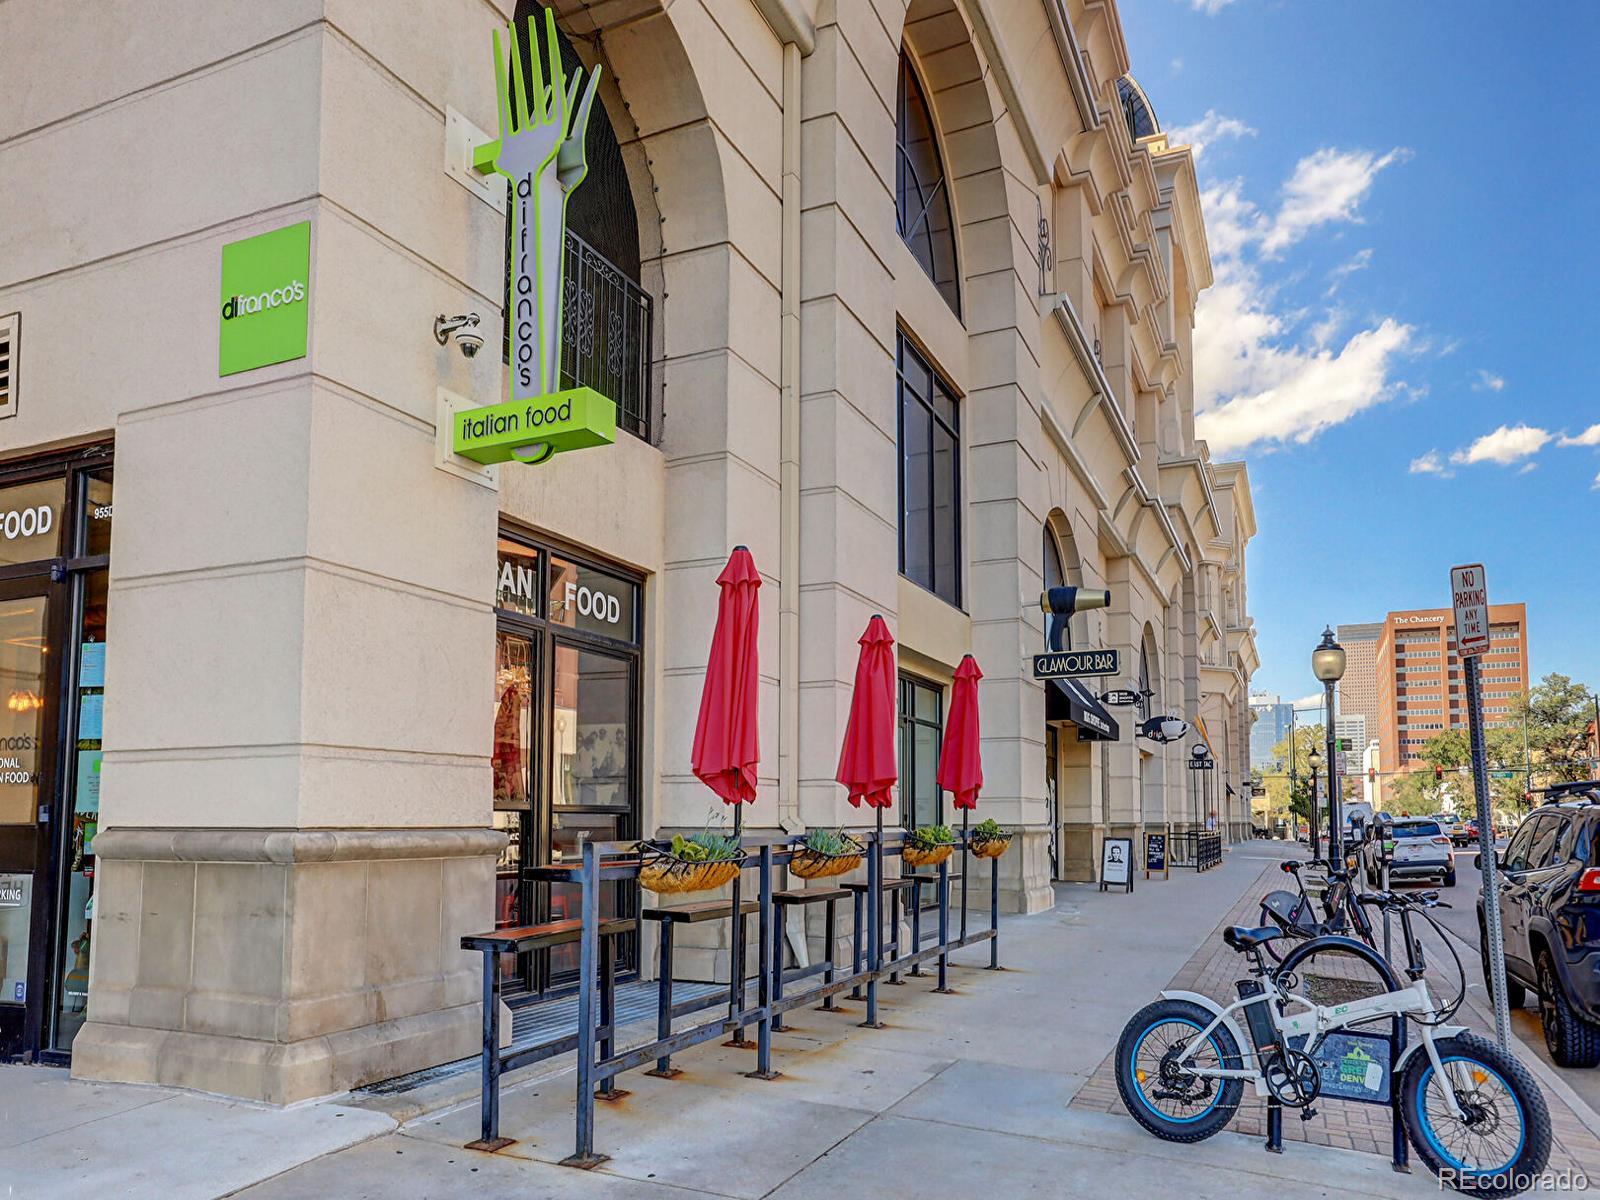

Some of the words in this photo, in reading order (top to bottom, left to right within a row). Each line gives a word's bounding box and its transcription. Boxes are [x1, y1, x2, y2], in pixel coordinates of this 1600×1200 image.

[516, 172, 532, 387] difranco's
[222, 280, 304, 320] difranco's
[462, 413, 518, 440] italian
[526, 398, 571, 428] food
[1461, 570, 1475, 588] NO
[564, 581, 620, 624] FOOD
[1455, 589, 1485, 609] PARKING
[1394, 616, 1409, 624] The
[1409, 615, 1445, 623] Chancery
[1464, 609, 1478, 621] ANY
[1464, 621, 1481, 634] TIME
[1037, 655, 1093, 673] GLAMOUR
[1095, 653, 1114, 670] BAR
[1147, 729, 1163, 740] drip
[5, 771, 29, 783] FOOD
[0, 888, 21, 900] KING
